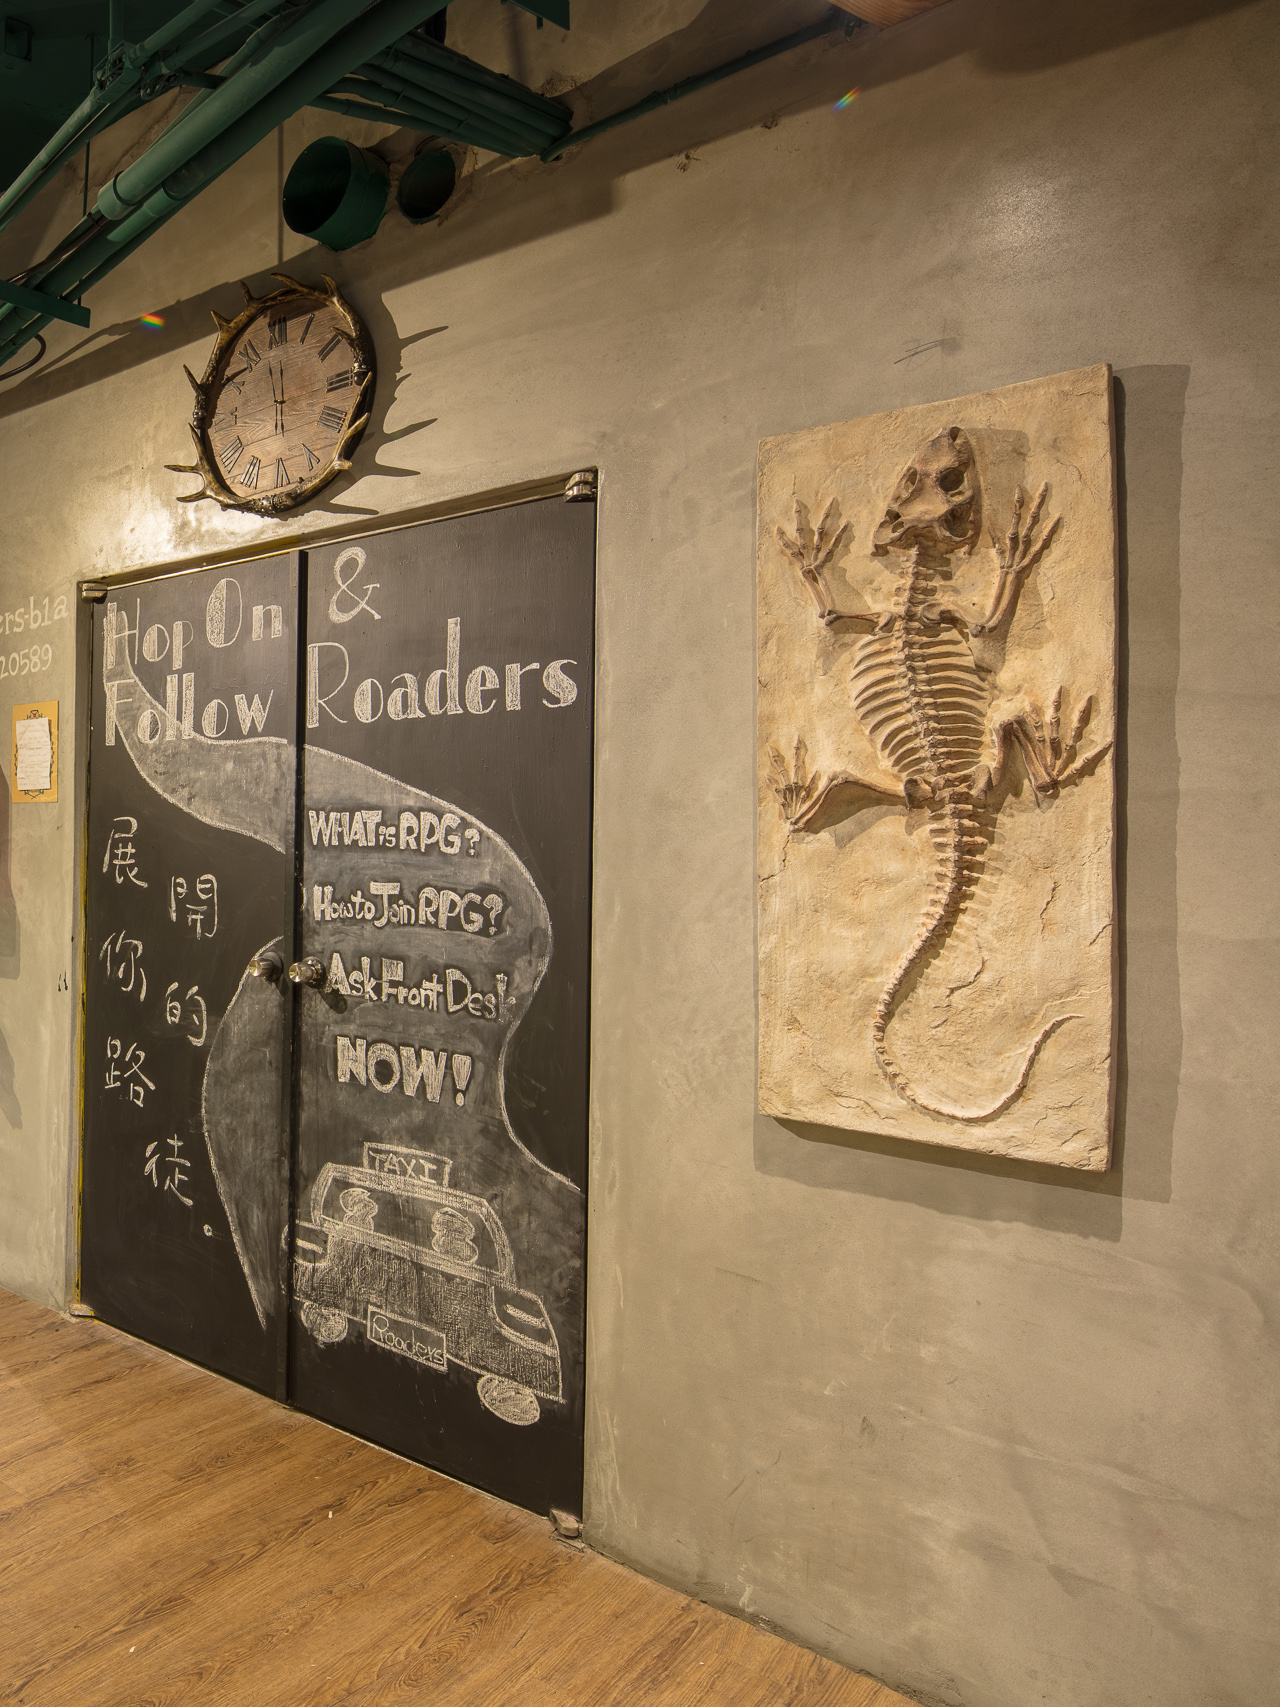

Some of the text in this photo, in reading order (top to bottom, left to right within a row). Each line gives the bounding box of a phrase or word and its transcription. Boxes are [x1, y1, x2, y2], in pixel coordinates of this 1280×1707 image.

[104, 546, 382, 670] Hop On &
[104, 616, 579, 746] Follow Roaders
[308, 809, 481, 856] WHAT is RPG?
[312, 881, 504, 936] How to Join RPG?
[324, 952, 517, 1024] Ask Front Desk
[336, 1034, 472, 1107] NOW!
[369, 1150, 438, 1184] TAXI
